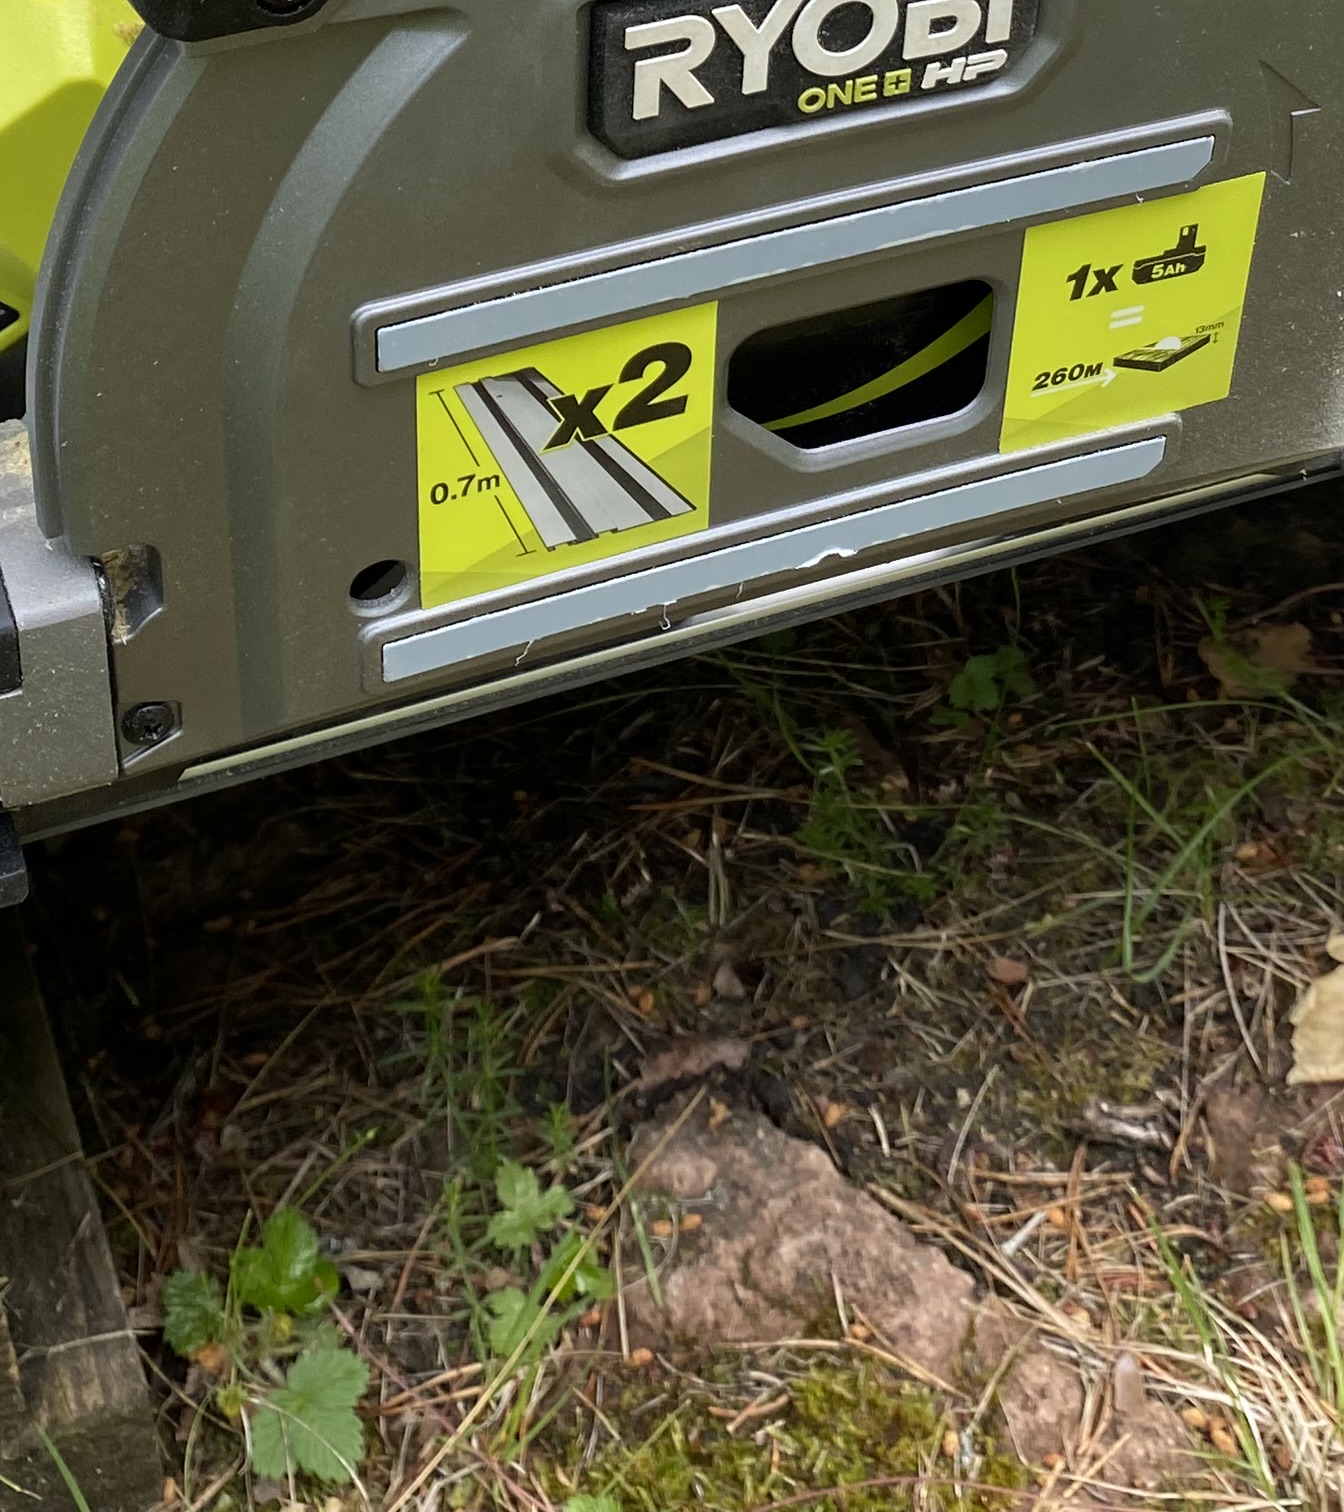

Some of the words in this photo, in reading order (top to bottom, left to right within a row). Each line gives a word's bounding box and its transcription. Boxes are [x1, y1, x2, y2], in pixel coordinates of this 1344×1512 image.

[921, 49, 1008, 90] HP
[1066, 263, 1124, 302] 1x
[1150, 261, 1187, 279] 5Ah
[1195, 320, 1225, 334] 13mm
[541, 342, 693, 452] x2
[430, 472, 501, 505] 0.7m
